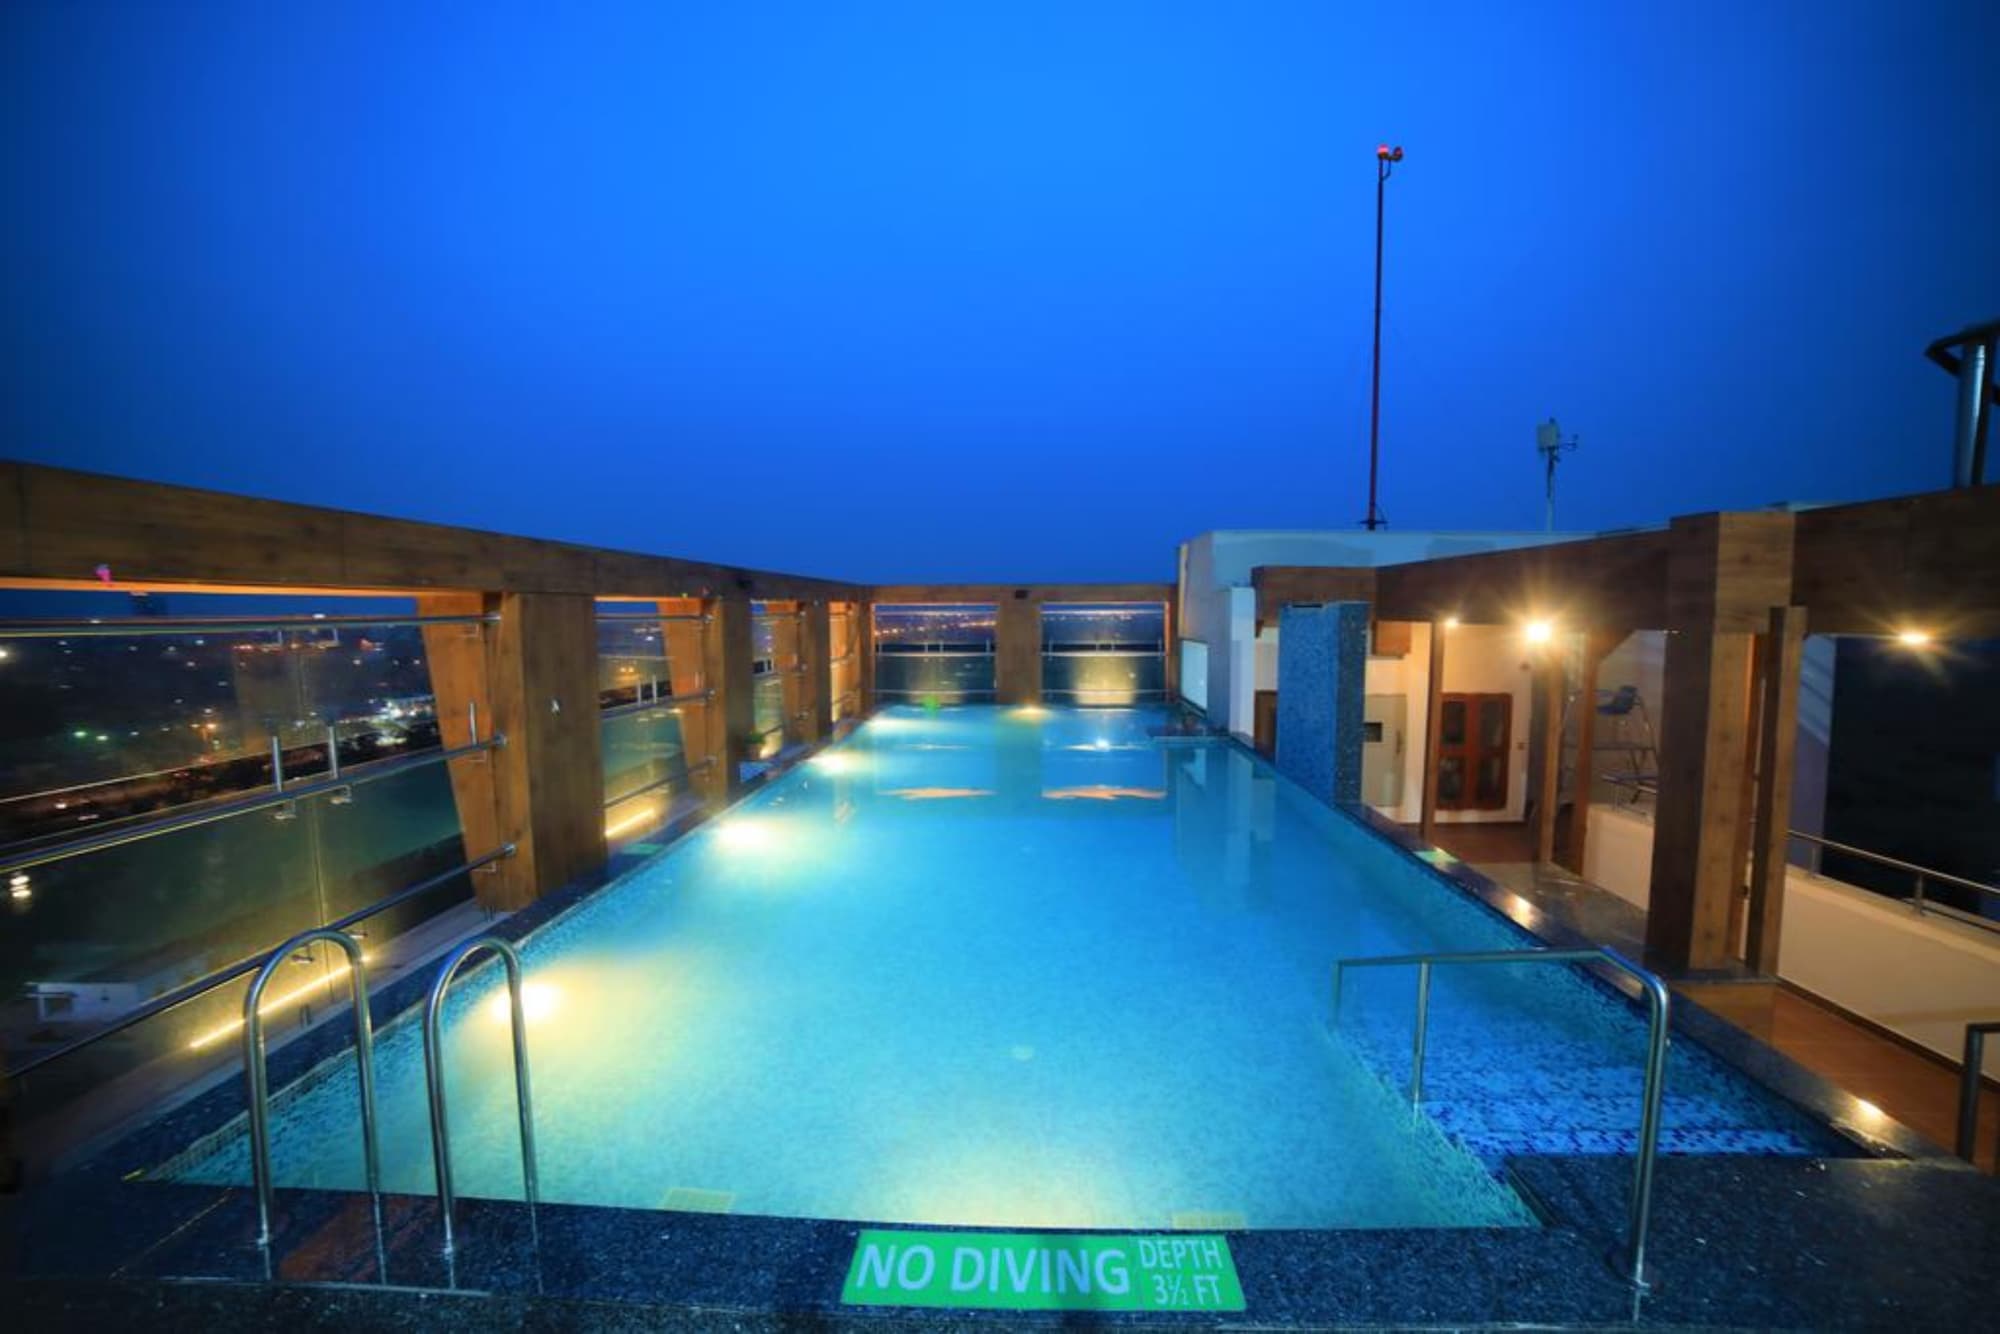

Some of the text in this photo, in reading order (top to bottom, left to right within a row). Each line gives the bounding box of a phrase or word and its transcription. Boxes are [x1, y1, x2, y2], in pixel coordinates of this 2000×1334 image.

[1138, 1239, 1223, 1268] DEPTH
[856, 1244, 1131, 1295] NO DIVING
[1193, 1275, 1221, 1305] FT
